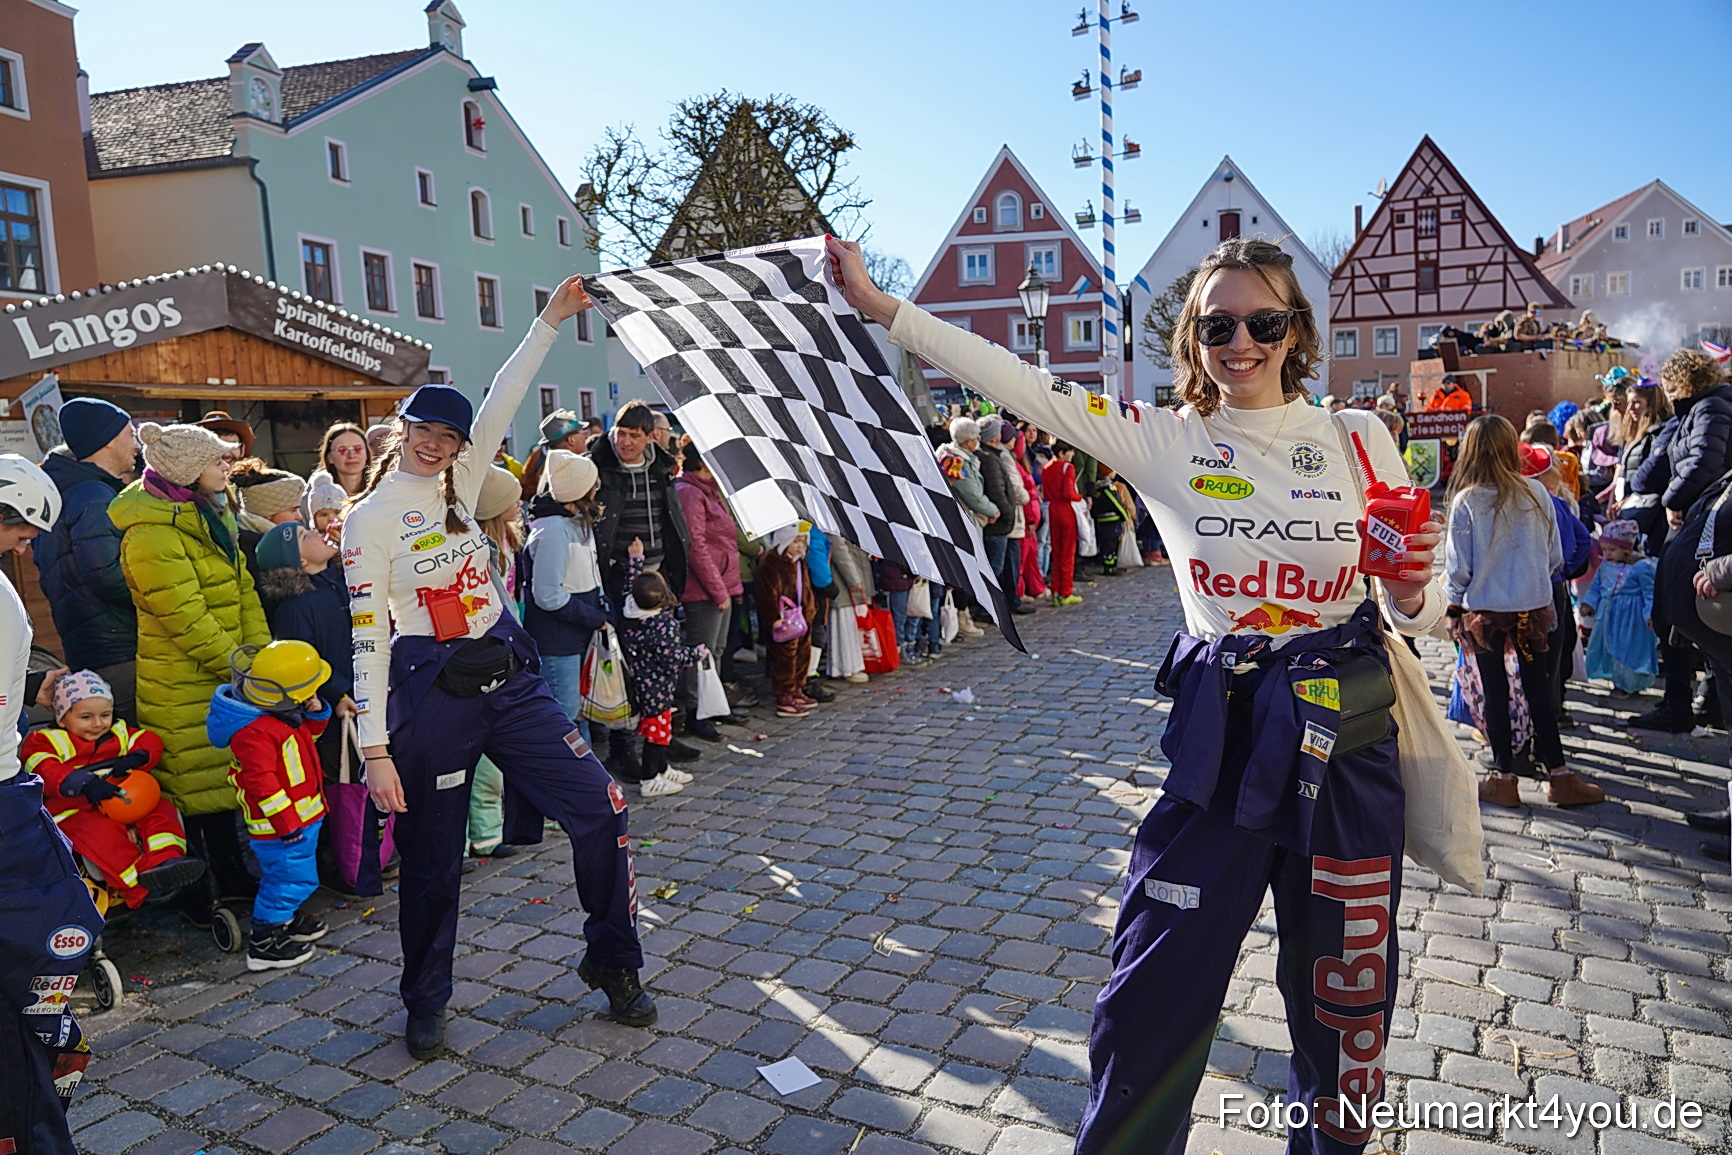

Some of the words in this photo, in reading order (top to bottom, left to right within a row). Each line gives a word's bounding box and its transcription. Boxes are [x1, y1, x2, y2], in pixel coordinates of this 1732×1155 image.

[12, 297, 183, 361] Langos
[276, 296, 396, 357] Spiralkartoffeln
[273, 318, 382, 372] Kartoffelchips
[1292, 453, 1325, 468] HSG
[1204, 479, 1248, 496] RAUCH
[1291, 489, 1327, 500] Mobil
[406, 515, 422, 524] Esso
[1195, 516, 1357, 543] ORACLE
[1371, 522, 1402, 551] FUEL
[414, 532, 489, 575] ORACLE
[1189, 558, 1269, 598] Red
[1275, 562, 1357, 603] Bull
[1309, 684, 1340, 701] RAU
[1309, 732, 1330, 752] VISA
[1146, 880, 1199, 909] Ronja
[54, 934, 85, 949] Esso
